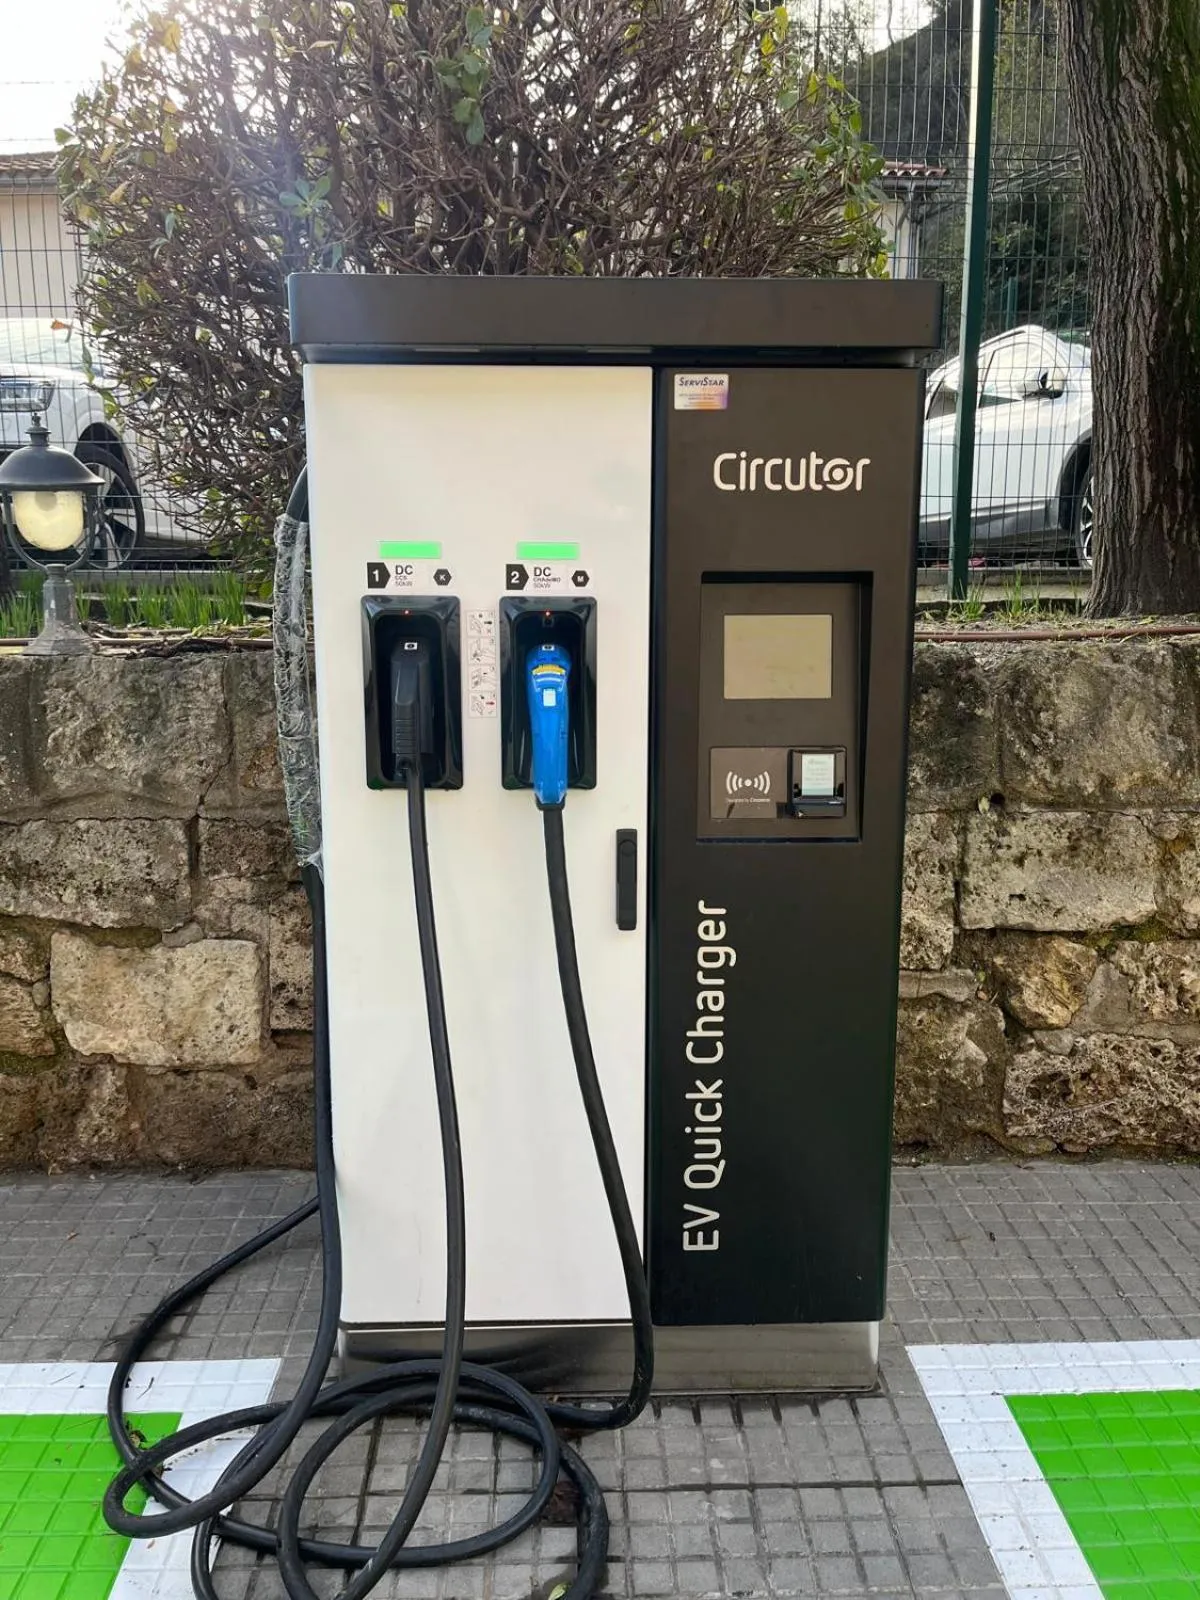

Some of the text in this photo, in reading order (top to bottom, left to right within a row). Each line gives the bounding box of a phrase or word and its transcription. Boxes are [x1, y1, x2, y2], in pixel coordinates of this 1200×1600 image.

[713, 450, 871, 492] Circutor
[371, 569, 380, 582] 1
[395, 564, 413, 575] DC
[533, 566, 552, 577] DC
[510, 570, 520, 584] 2
[682, 899, 737, 1251] EV Quick Charger
